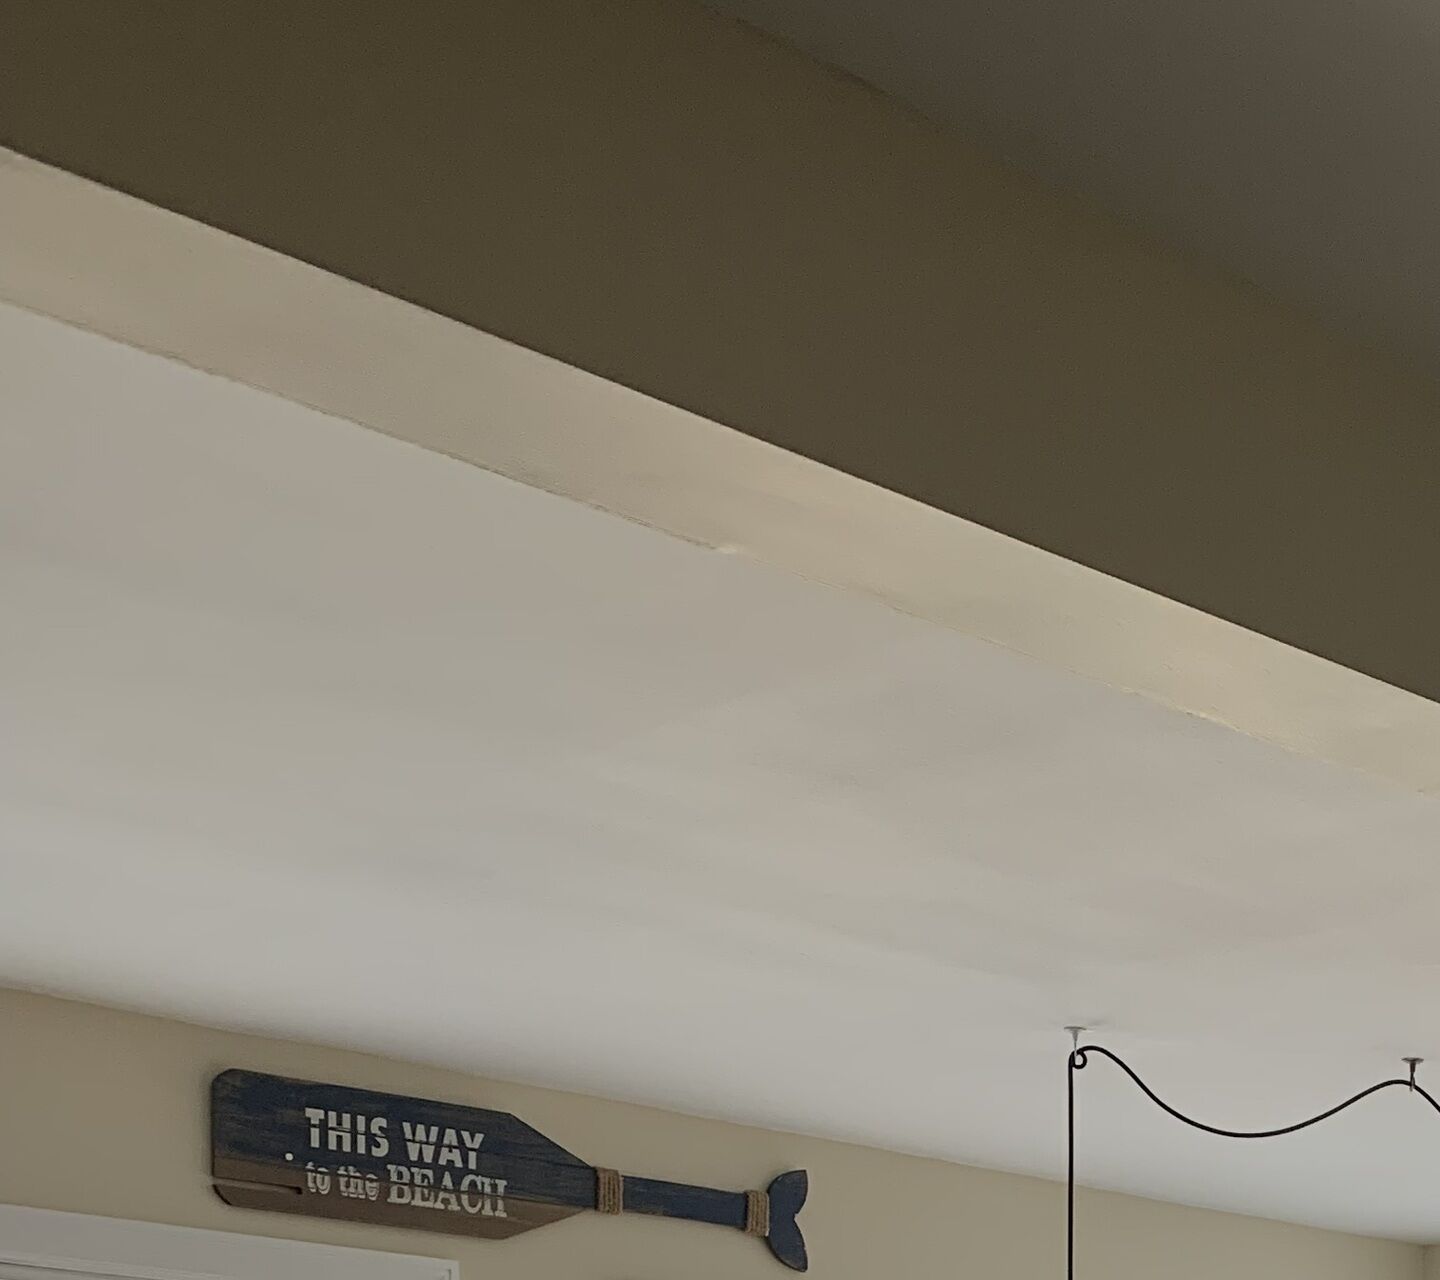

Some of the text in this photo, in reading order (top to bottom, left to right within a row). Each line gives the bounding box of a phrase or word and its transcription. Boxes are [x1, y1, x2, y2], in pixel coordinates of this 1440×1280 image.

[304, 1106, 485, 1171] THIS WAY
[305, 1160, 509, 1218] to the BEACH
